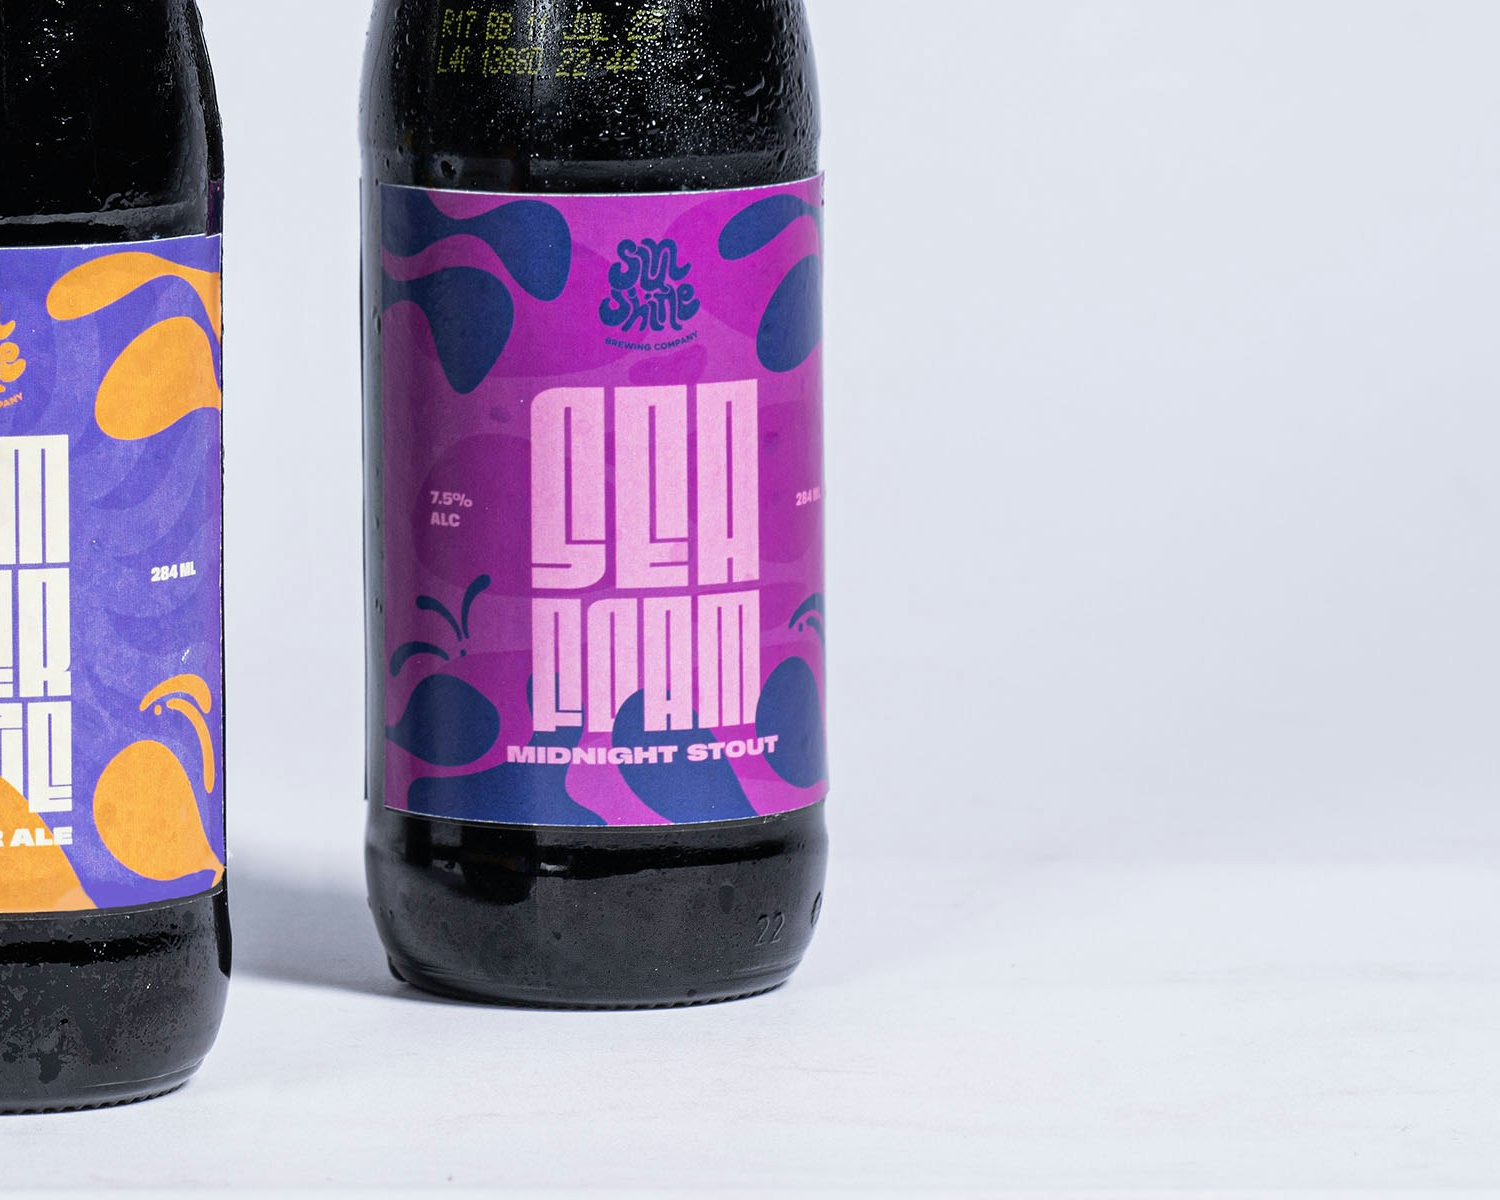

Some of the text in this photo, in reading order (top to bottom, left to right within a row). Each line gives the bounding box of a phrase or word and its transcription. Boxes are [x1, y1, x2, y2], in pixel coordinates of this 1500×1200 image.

[604, 329, 698, 352] BREWING COMPANY
[531, 379, 760, 590] SEA
[430, 490, 473, 508] 7.5%
[430, 512, 460, 527] ALC
[150, 560, 197, 582] 284 ML
[506, 735, 779, 765] MIDNIGHT STOUT
[10, 826, 73, 848] ALE
